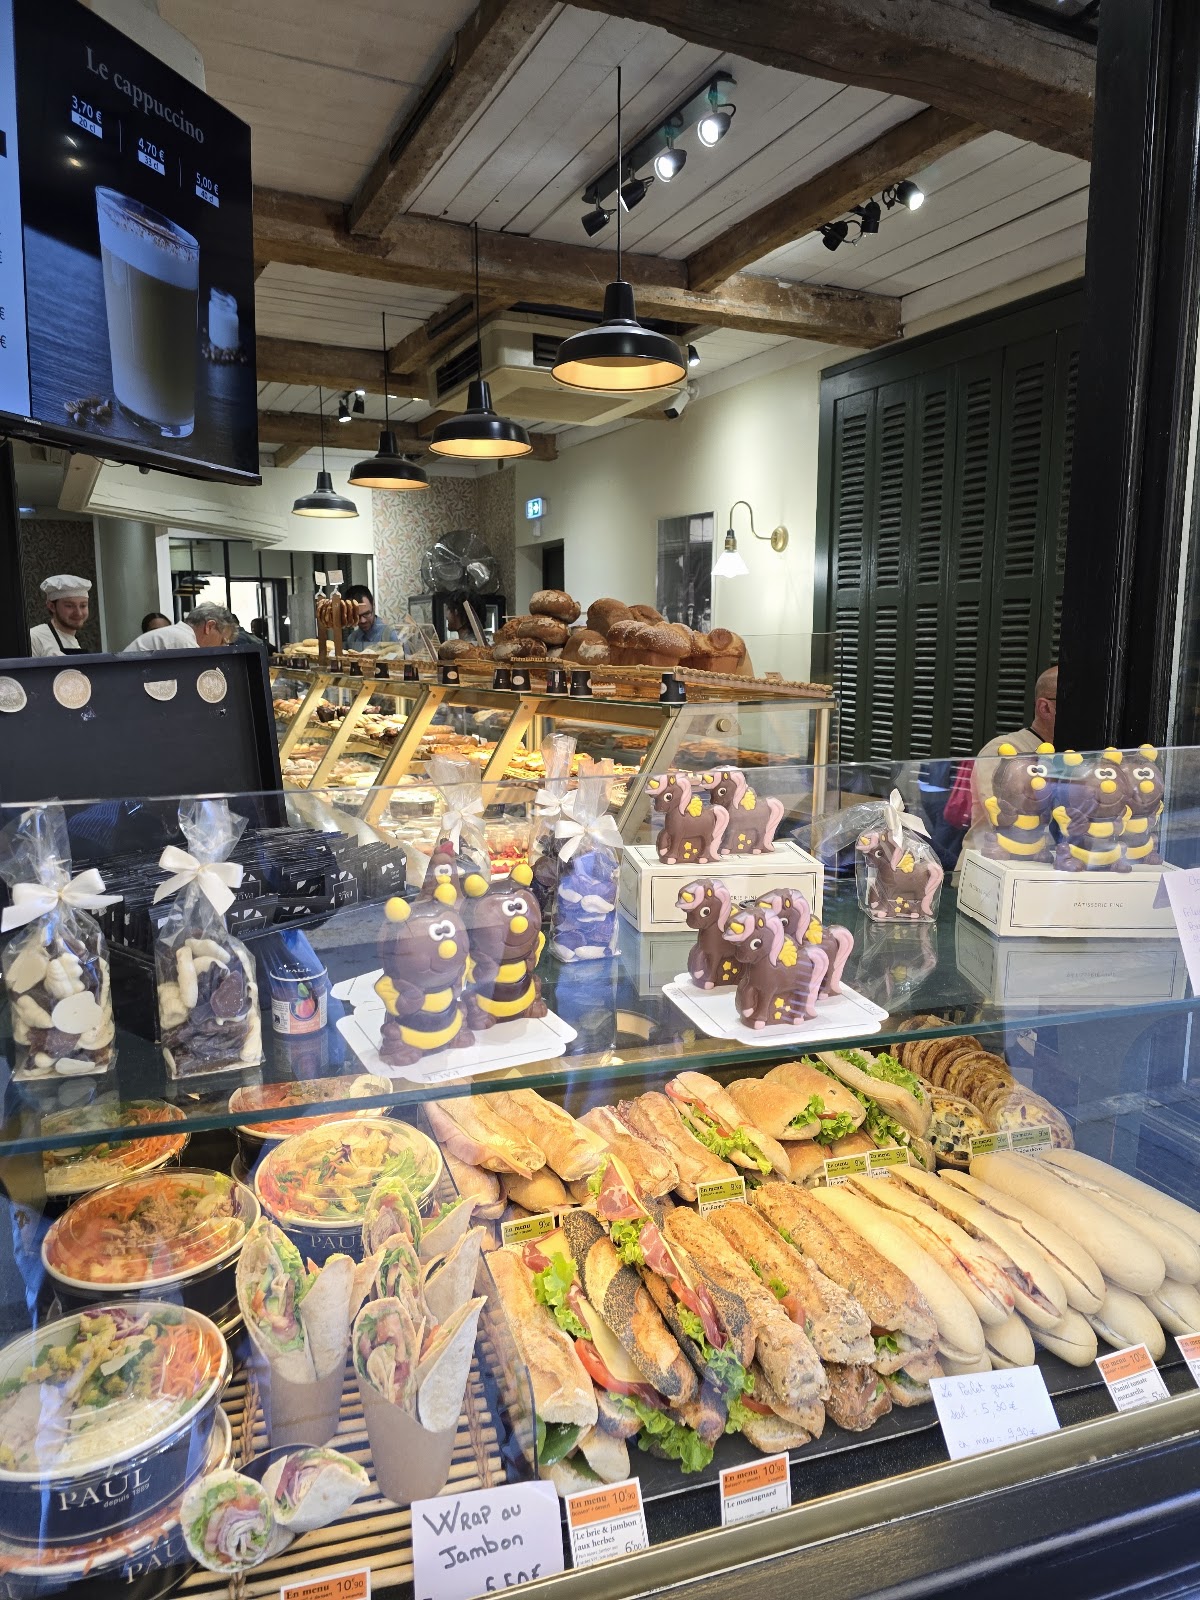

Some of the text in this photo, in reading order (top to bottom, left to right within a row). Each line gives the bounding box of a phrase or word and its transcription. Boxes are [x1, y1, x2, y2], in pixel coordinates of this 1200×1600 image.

[86, 46, 205, 144] Le cappuccino
[71, 95, 94, 118] 3,70
[138, 138, 157, 158] 4,70
[724, 1474, 735, 1482] En
[737, 1468, 758, 1479] menu
[58, 1467, 152, 1512] PAUL
[103, 1483, 151, 1508] depuis 1889
[736, 1489, 776, 1504] montagnard
[571, 1501, 582, 1510] En
[584, 1495, 607, 1508] menu
[576, 1520, 637, 1540] Le brie & jambon
[438, 1534, 524, 1570] Jambon
[578, 1536, 616, 1551] aux herbes
[126, 1540, 184, 1585] PAU
[286, 1592, 299, 1600] En
[302, 1584, 330, 1596] menu
